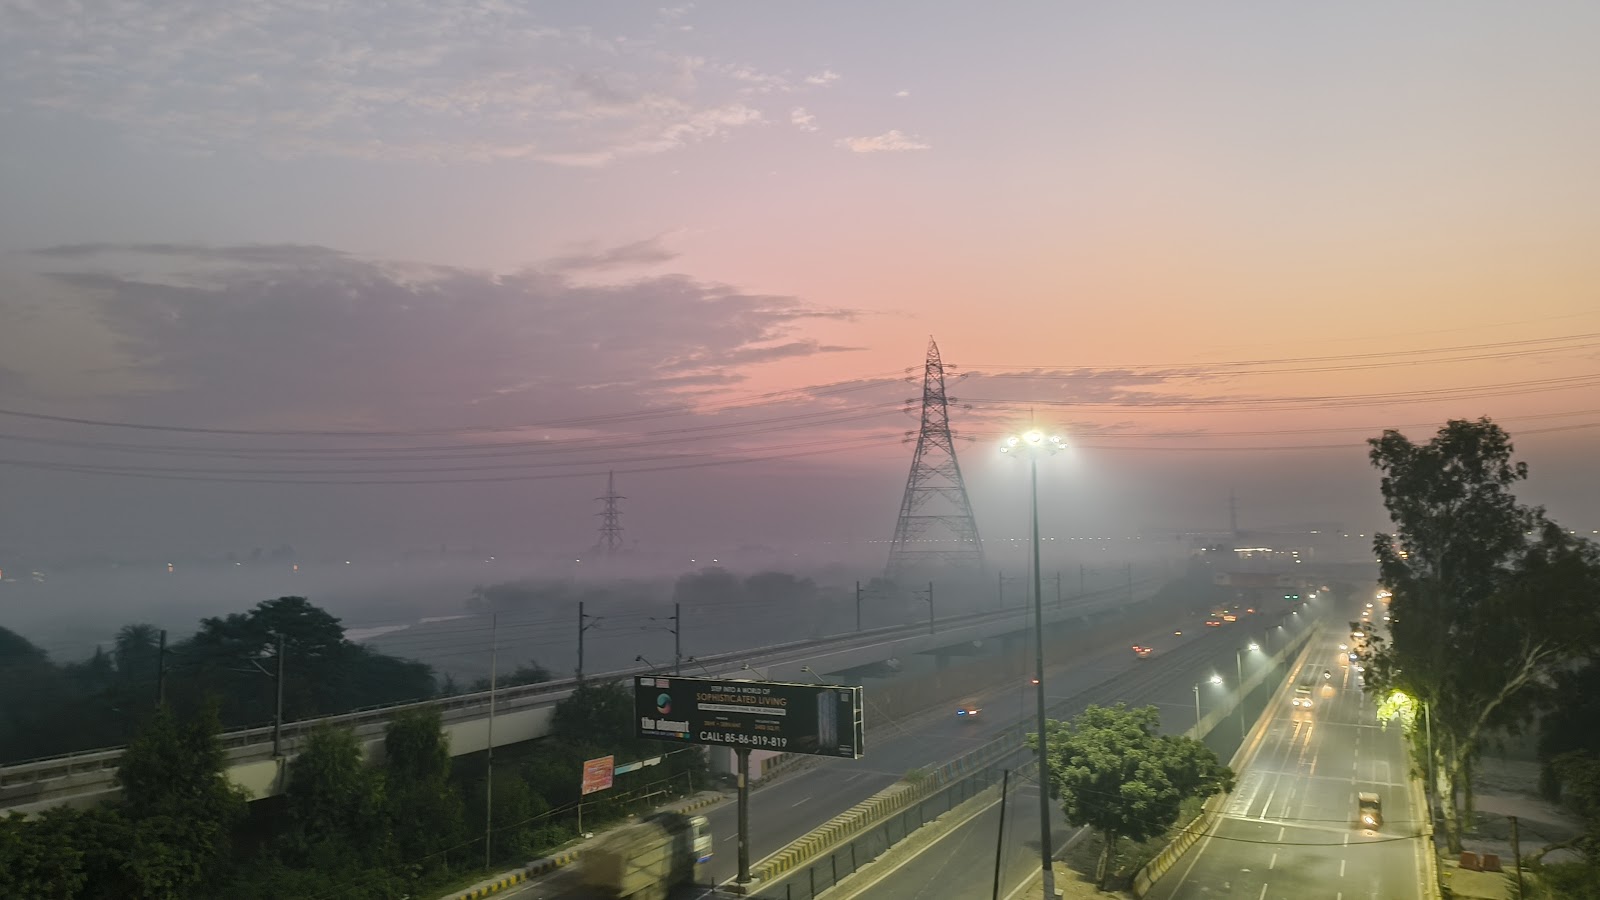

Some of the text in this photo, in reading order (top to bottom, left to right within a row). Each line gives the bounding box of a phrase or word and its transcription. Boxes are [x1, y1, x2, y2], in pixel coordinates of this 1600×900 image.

[743, 687, 761, 695] WORLD
[696, 692, 787, 707] SOPHISTICATED LIVING
[641, 716, 655, 730] the
[700, 731, 723, 742] CALL:
[725, 733, 787, 747] 85-86-819-819
